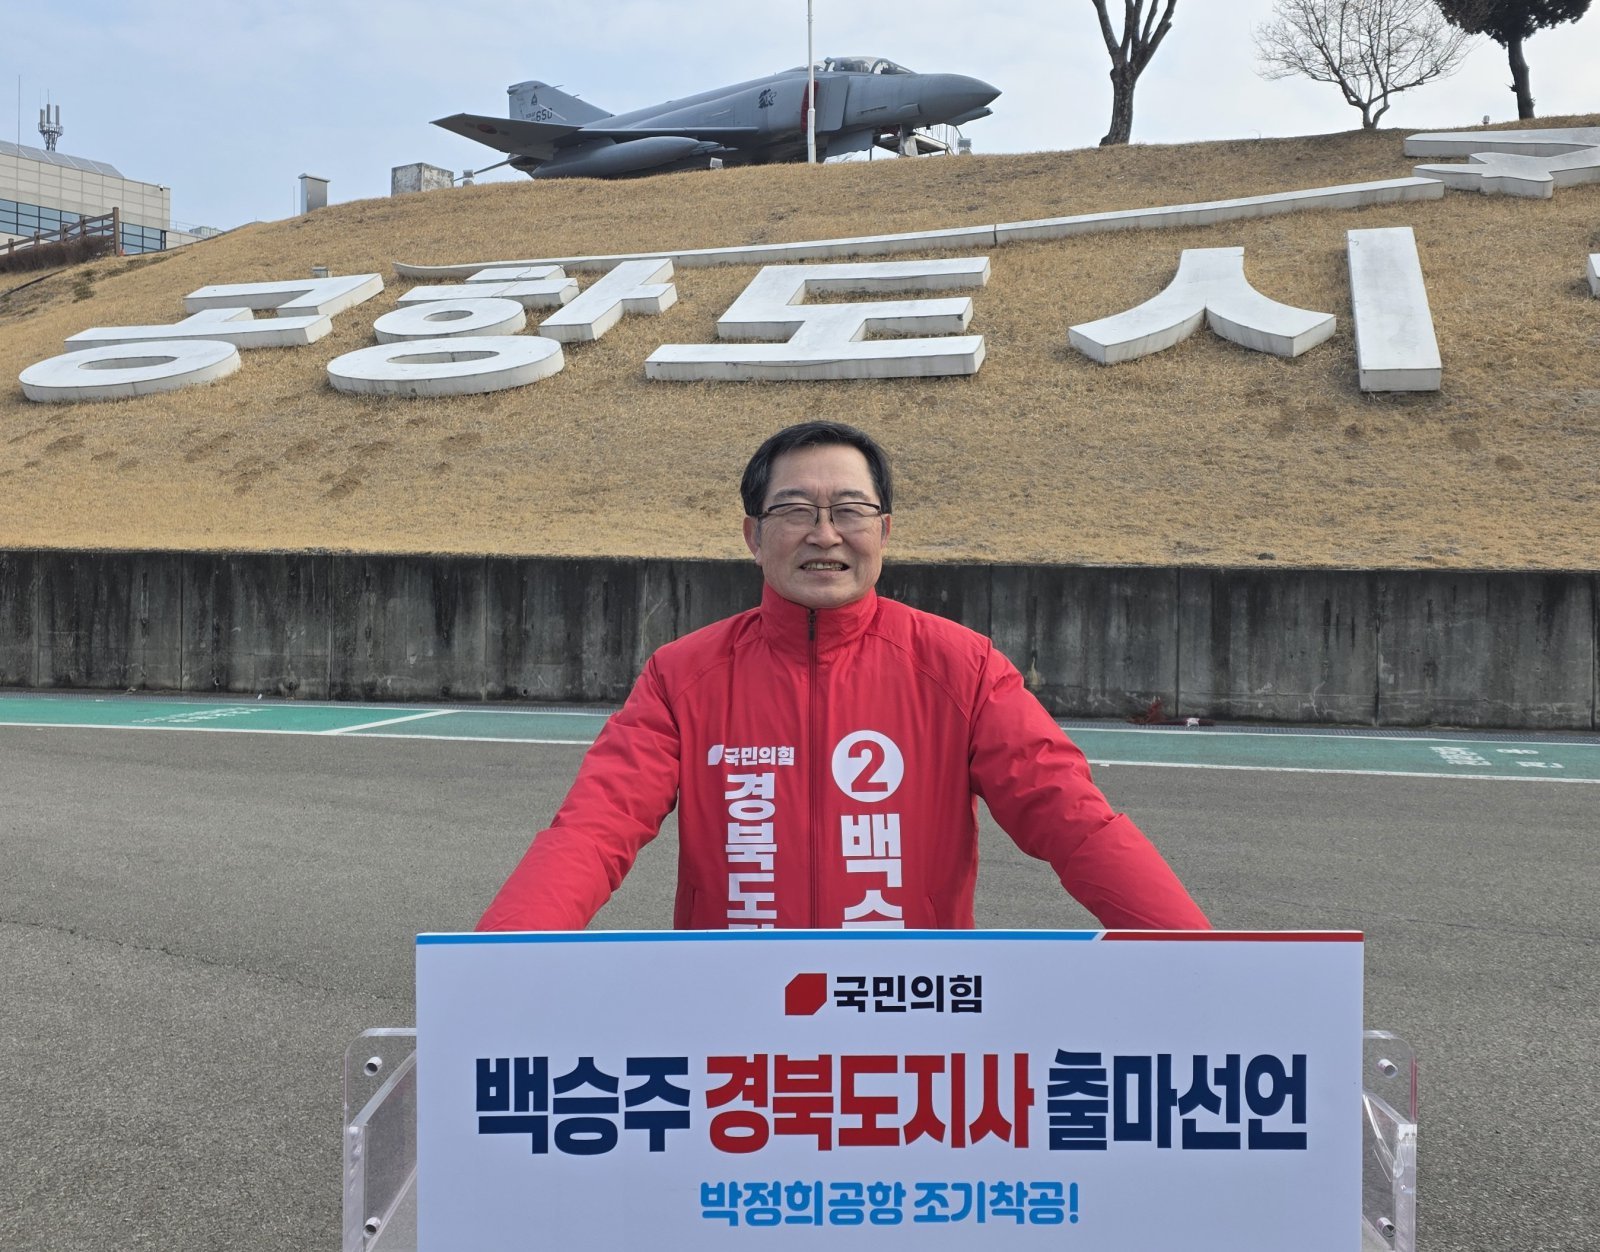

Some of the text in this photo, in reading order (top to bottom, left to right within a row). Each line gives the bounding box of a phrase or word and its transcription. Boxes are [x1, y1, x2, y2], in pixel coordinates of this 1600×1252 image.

[18, 226, 1442, 405] 공항도시
[724, 745, 795, 767] 국민의힘
[845, 737, 891, 795] 2
[724, 772, 778, 929] 경북도
[833, 974, 983, 1014] 국민의힘
[475, 1048, 1308, 1156] 백승주 경북도지사 출마선언
[700, 1179, 1079, 1227] 박정희공항 조기착공!
